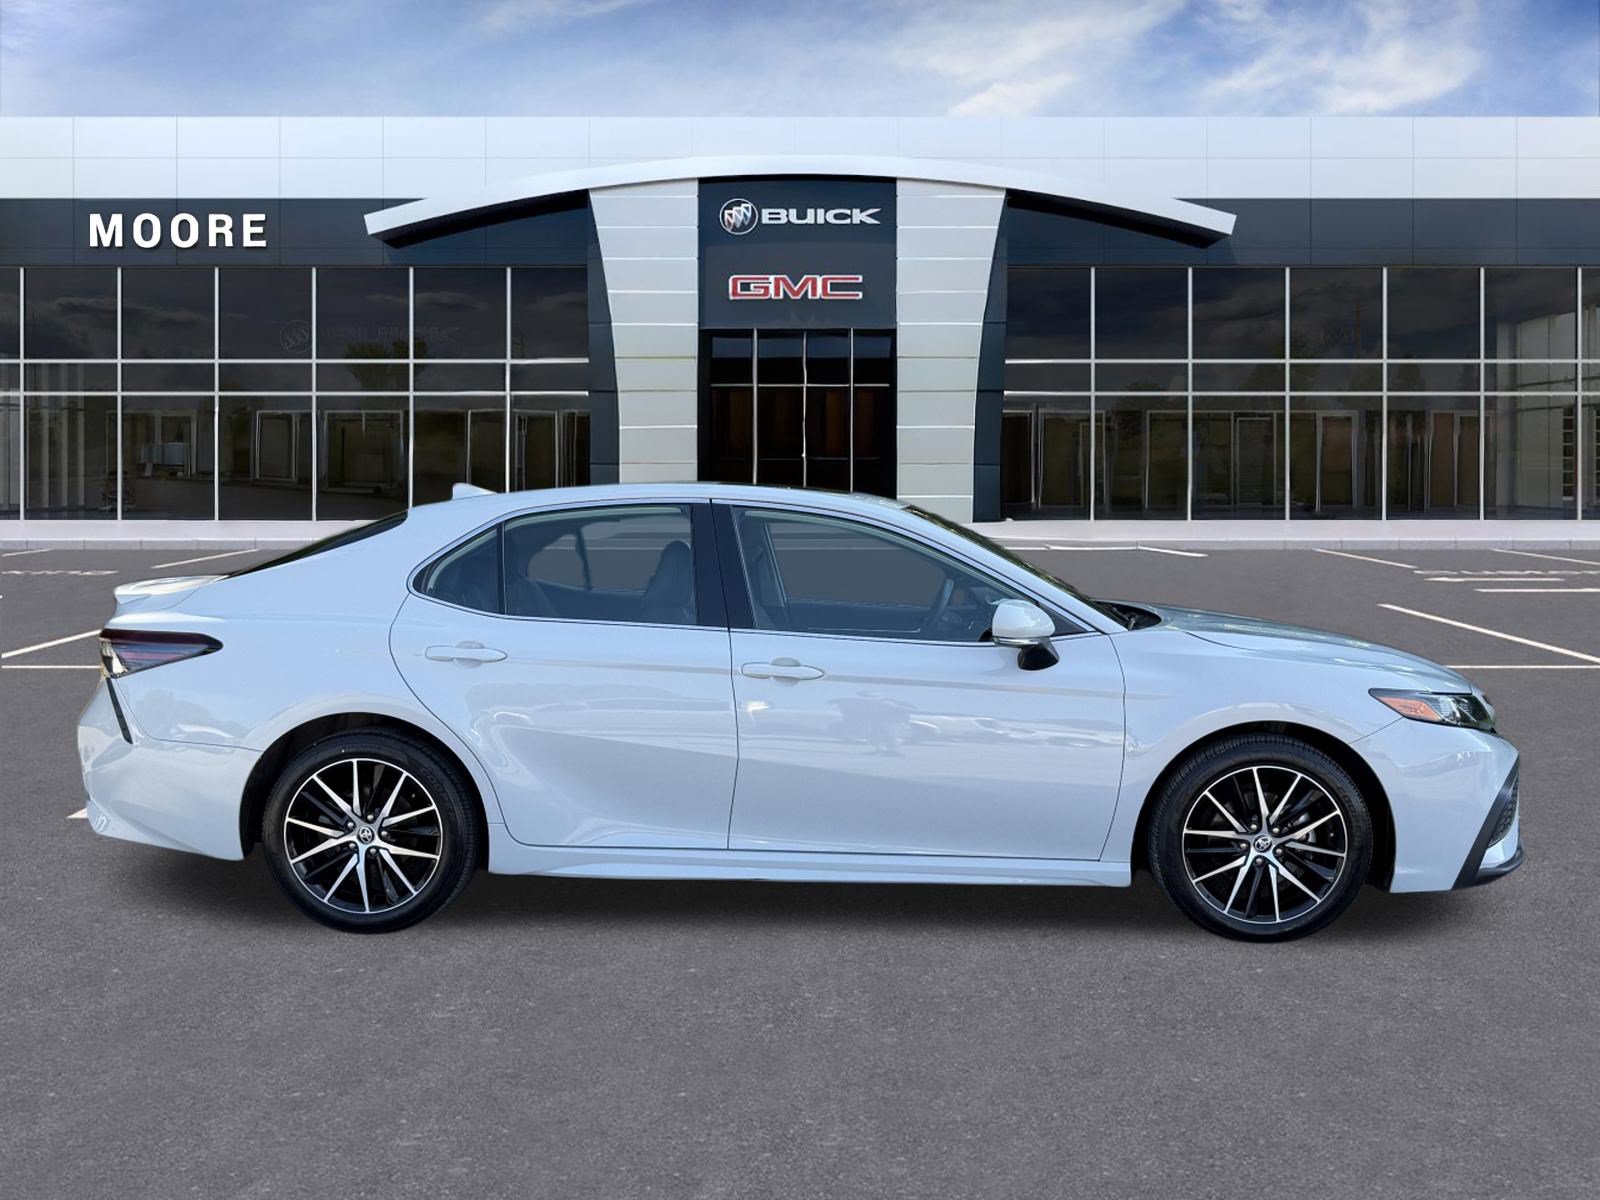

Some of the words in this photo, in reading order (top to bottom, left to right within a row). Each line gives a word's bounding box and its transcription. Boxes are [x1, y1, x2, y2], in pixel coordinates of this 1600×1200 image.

[761, 208, 881, 225] BUICK
[89, 212, 267, 249] MOORE
[728, 274, 864, 301] GMC
